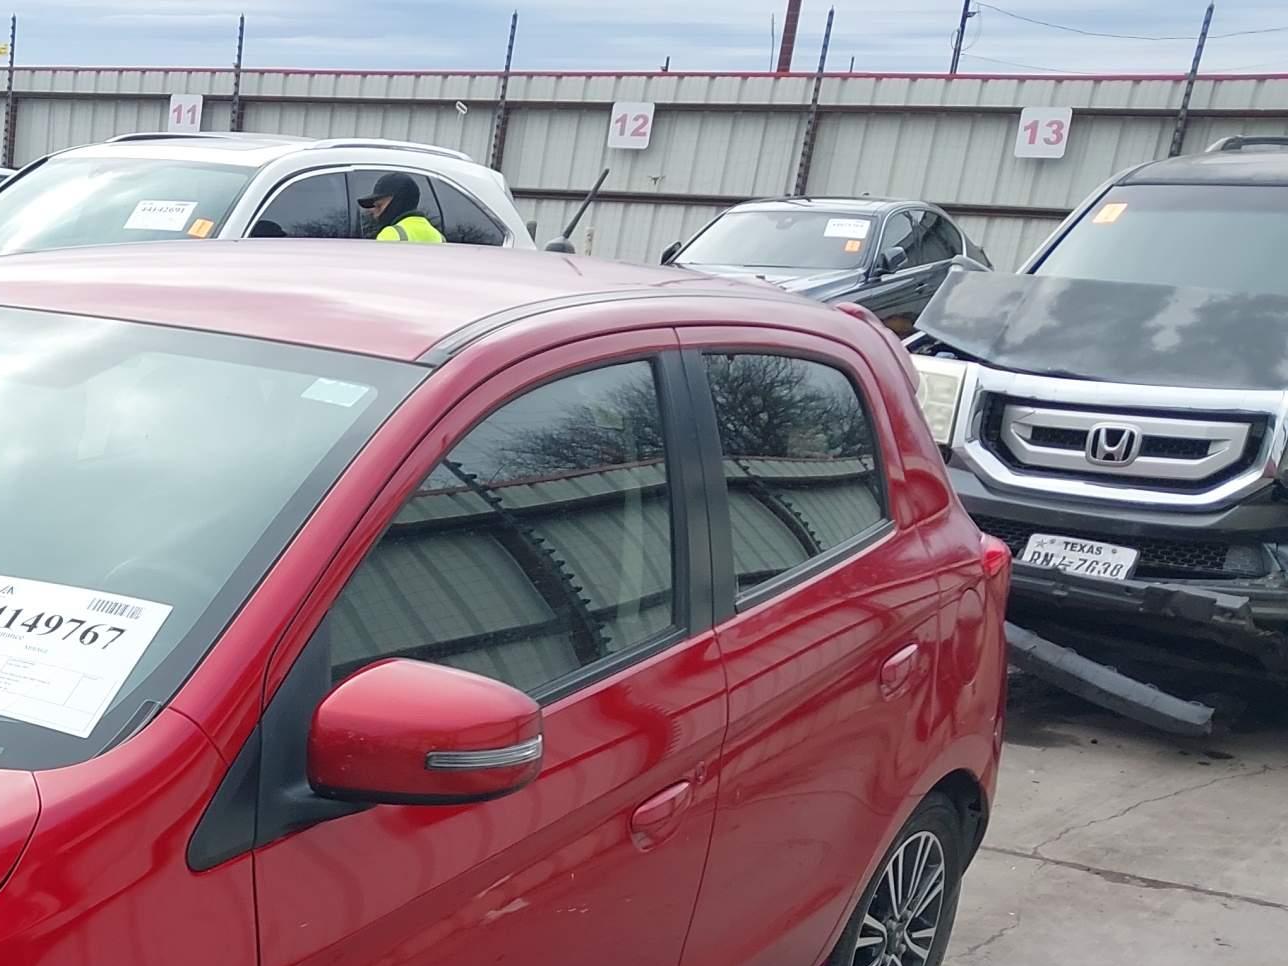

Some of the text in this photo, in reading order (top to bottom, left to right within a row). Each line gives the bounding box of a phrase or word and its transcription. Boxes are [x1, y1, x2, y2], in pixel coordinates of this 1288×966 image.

[172, 103, 197, 125] 11
[615, 113, 649, 137] 12
[1023, 119, 1065, 146] 13
[1063, 541, 1103, 556] TEXAS
